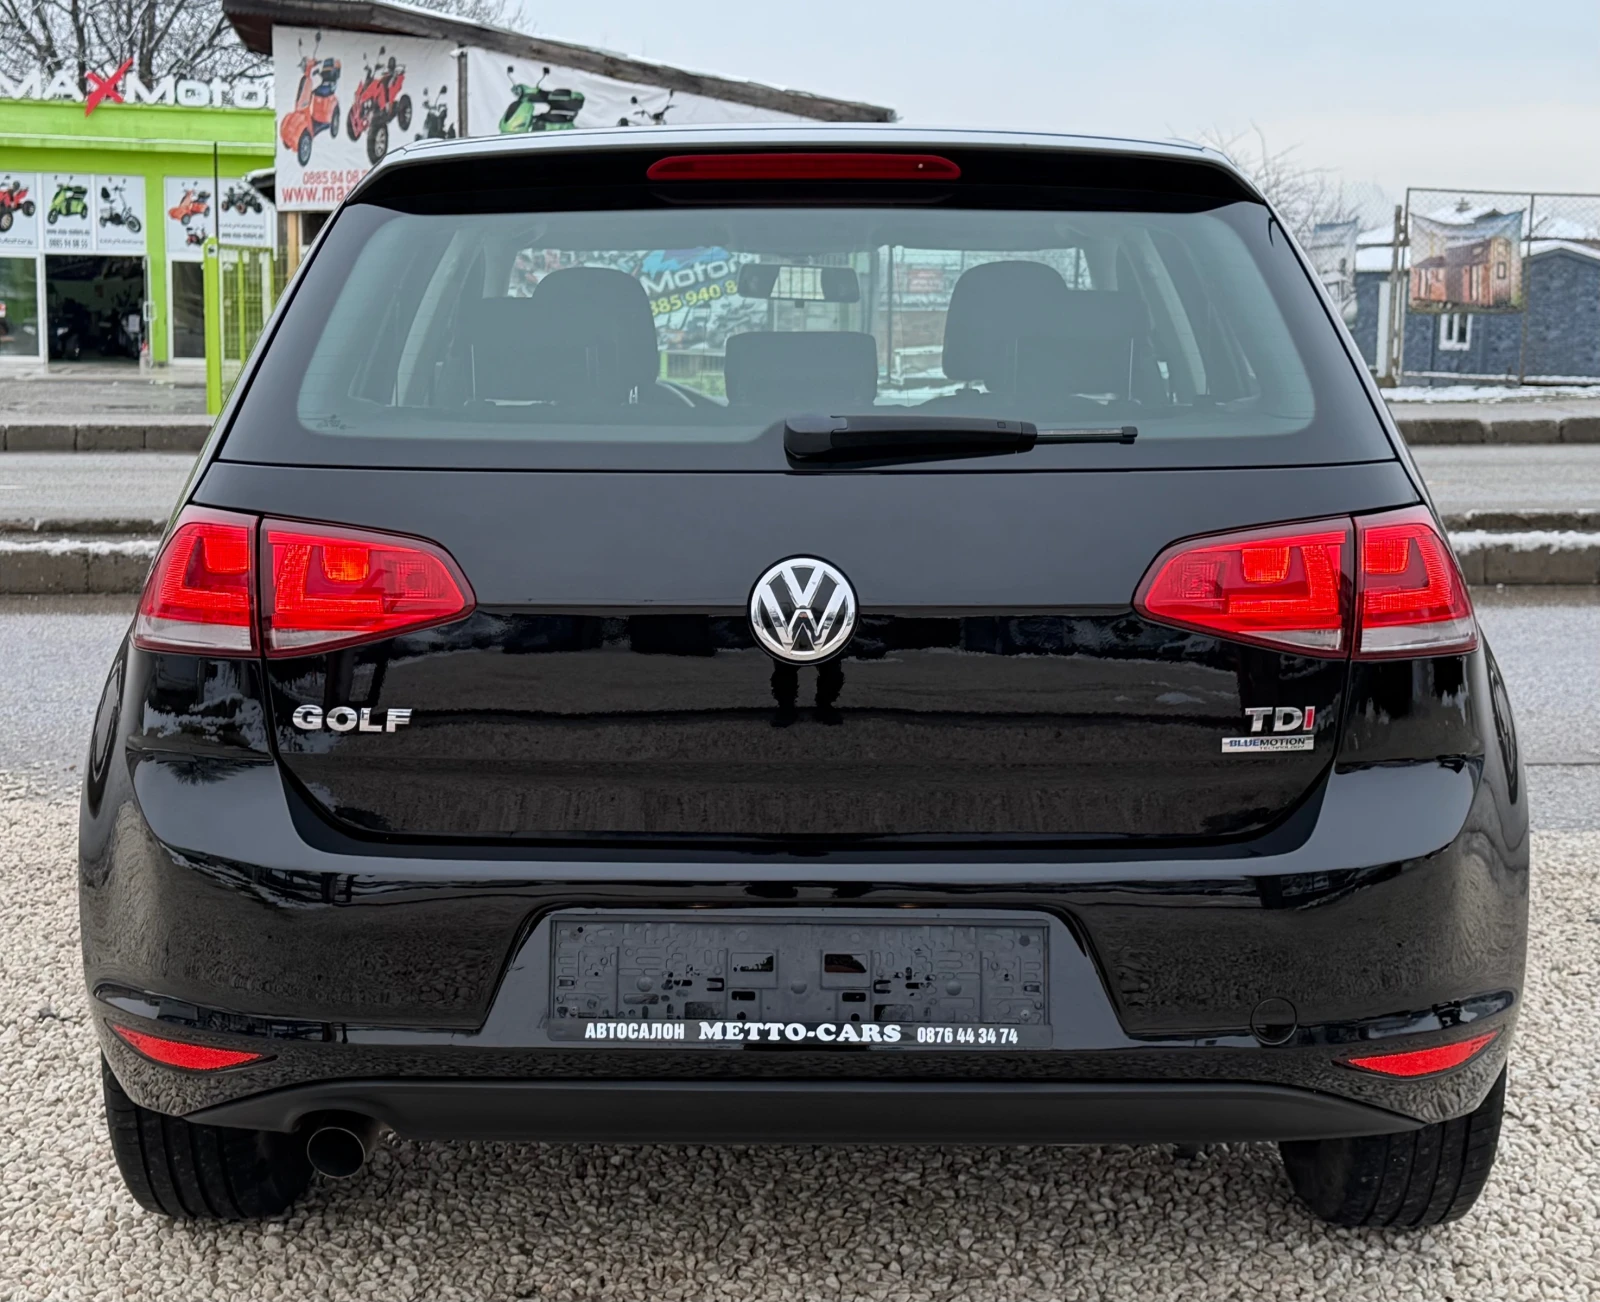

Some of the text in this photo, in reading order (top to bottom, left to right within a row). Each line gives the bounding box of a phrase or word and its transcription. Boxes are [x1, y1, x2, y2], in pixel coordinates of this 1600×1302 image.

[685, 283, 721, 306] 940
[725, 279, 738, 294] 8
[292, 704, 413, 732] GOLF
[1245, 706, 1316, 732] TDI
[1229, 737, 1305, 748] BLUEMOTION
[585, 1021, 1019, 1045] АВТОСАЛОН METTO-CARS 0876 44 34 74
